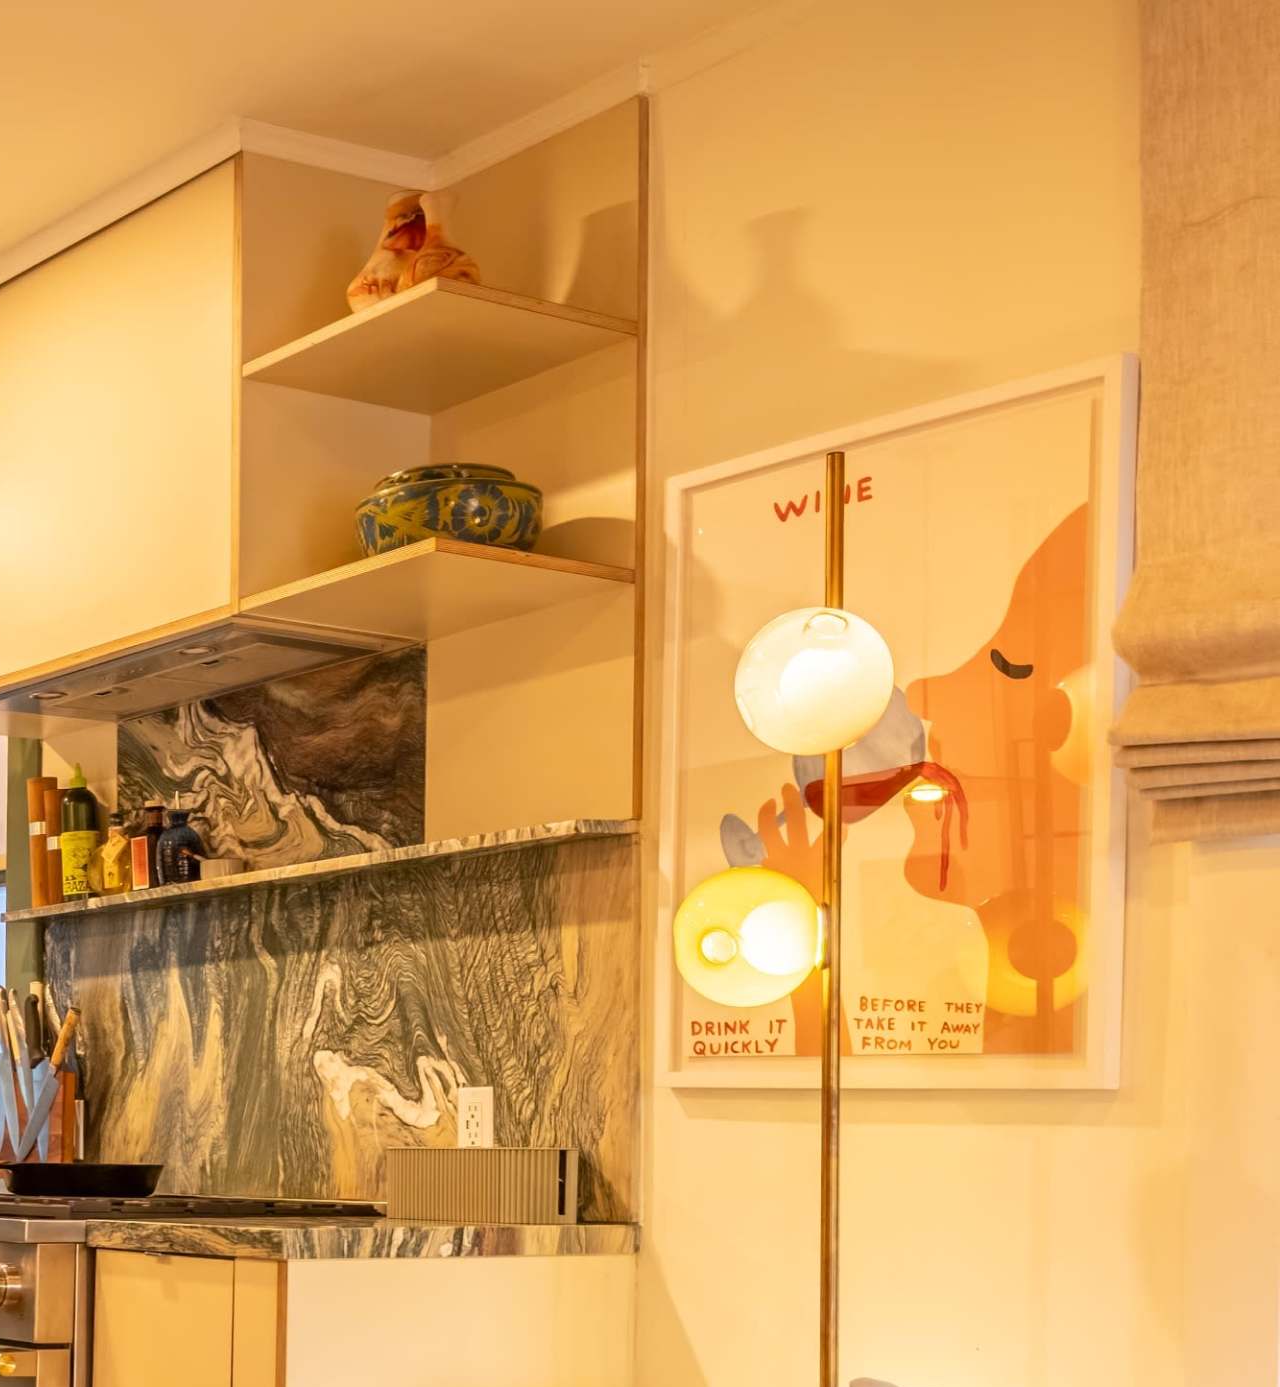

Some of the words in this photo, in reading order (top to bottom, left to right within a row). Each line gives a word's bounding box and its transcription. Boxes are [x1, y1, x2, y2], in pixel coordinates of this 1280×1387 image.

[859, 995, 927, 1013] BEFORE
[945, 1001, 984, 1015] THEY
[690, 1019, 750, 1036] DRINK
[769, 1018, 787, 1034] IT
[853, 1017, 897, 1031] TAKE
[910, 1020, 928, 1033] IT
[940, 1020, 982, 1036] AWAY
[693, 1037, 779, 1056] QUICKLY
[861, 1035, 913, 1051] FROM
[927, 1037, 961, 1051] YOU
